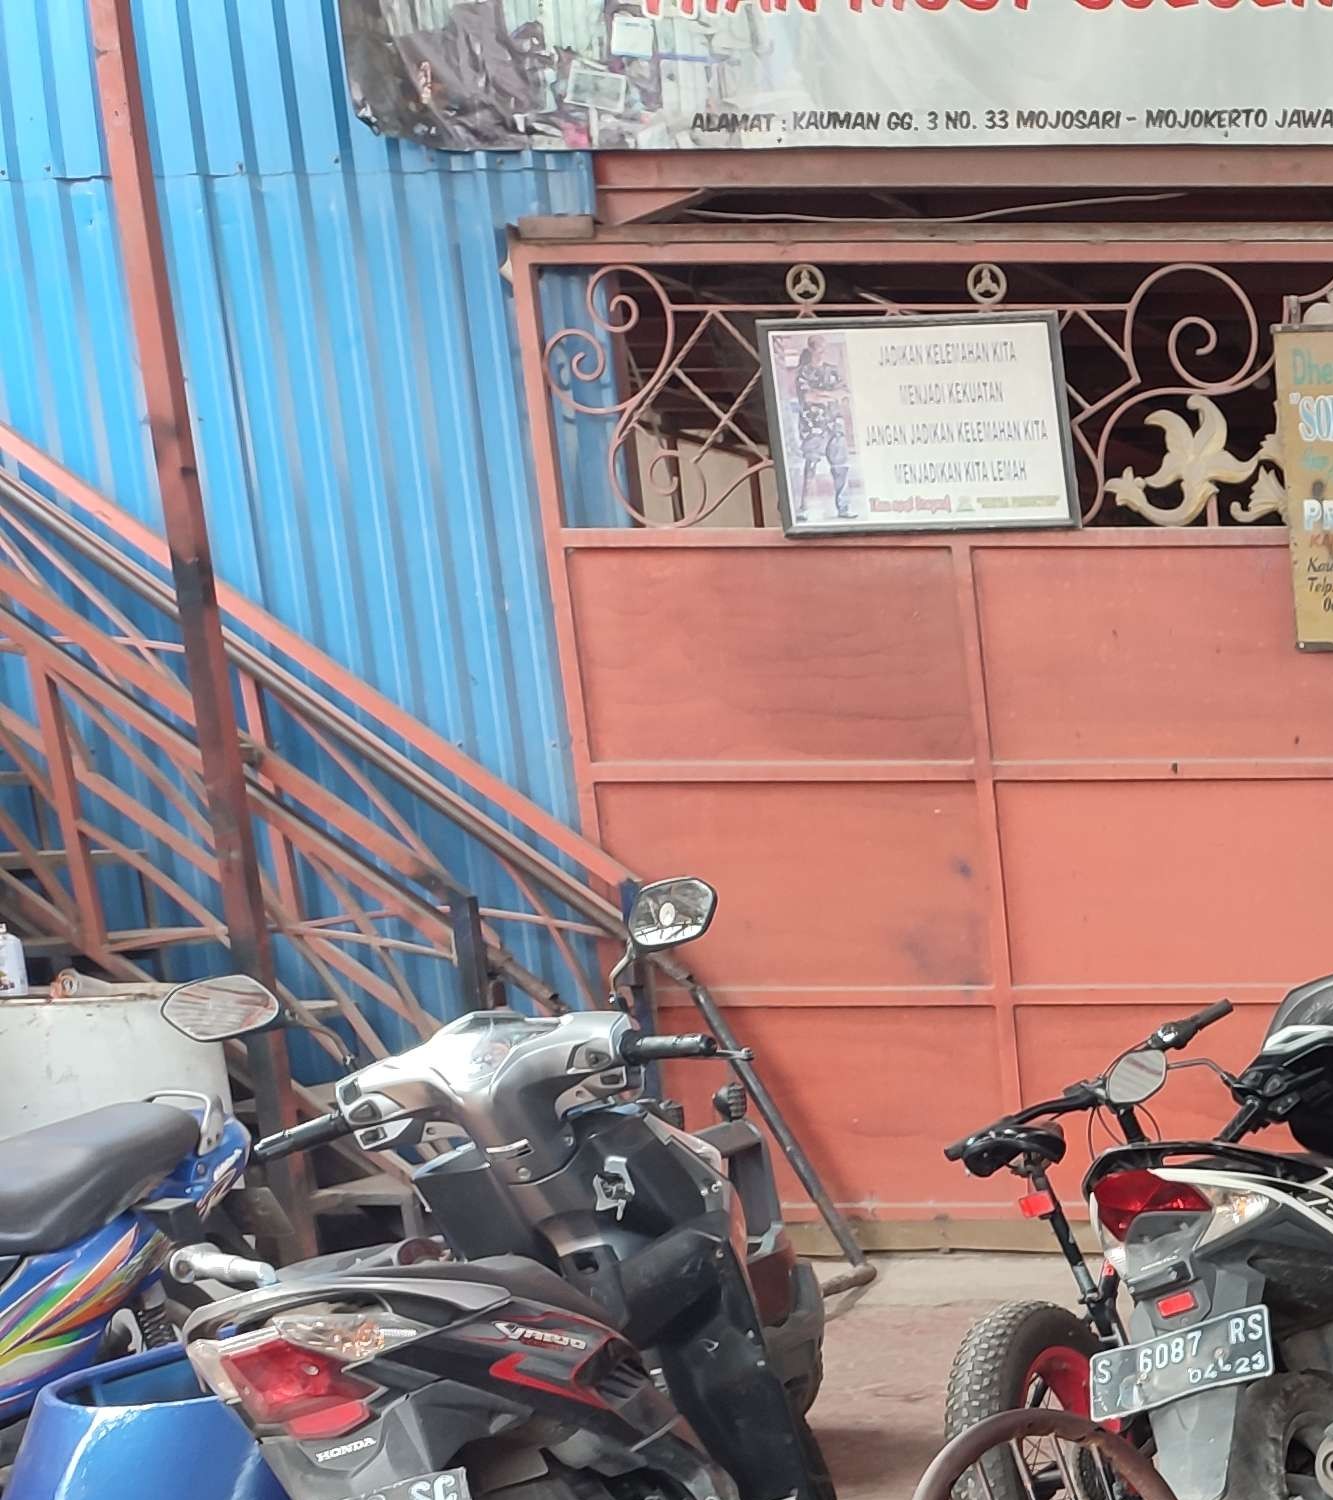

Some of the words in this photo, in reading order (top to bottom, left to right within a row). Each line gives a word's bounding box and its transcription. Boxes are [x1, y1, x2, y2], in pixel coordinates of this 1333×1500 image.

[691, 112, 776, 133] ALAMAT
[792, 110, 881, 131] KAUMAN
[887, 110, 918, 132] GG.
[927, 110, 939, 130] 3
[944, 110, 978, 130] NO.
[984, 110, 1009, 130] 33
[1015, 109, 1122, 130] MOJOSARI
[1145, 108, 1268, 129] MOJOKERTO
[879, 345, 923, 366] JADIKAN
[926, 342, 990, 365] KELEMAHAN
[992, 341, 1017, 362] KITA
[900, 383, 944, 405] MENJADI
[949, 381, 1004, 404] KEKUATAN
[866, 424, 907, 446] JANGAN
[911, 423, 954, 445] JADIKAN
[957, 421, 1021, 444] KELEMAHAN
[1024, 419, 1048, 441] KITA
[894, 462, 962, 485] MENJADIKAN
[964, 461, 990, 482] KITA
[991, 460, 1027, 482] LEMAH
[1097, 1359, 1112, 1385] S
[1139, 1330, 1203, 1373] 6087
[1229, 1313, 1264, 1345] RS
[315, 1436, 377, 1463] HONDA
